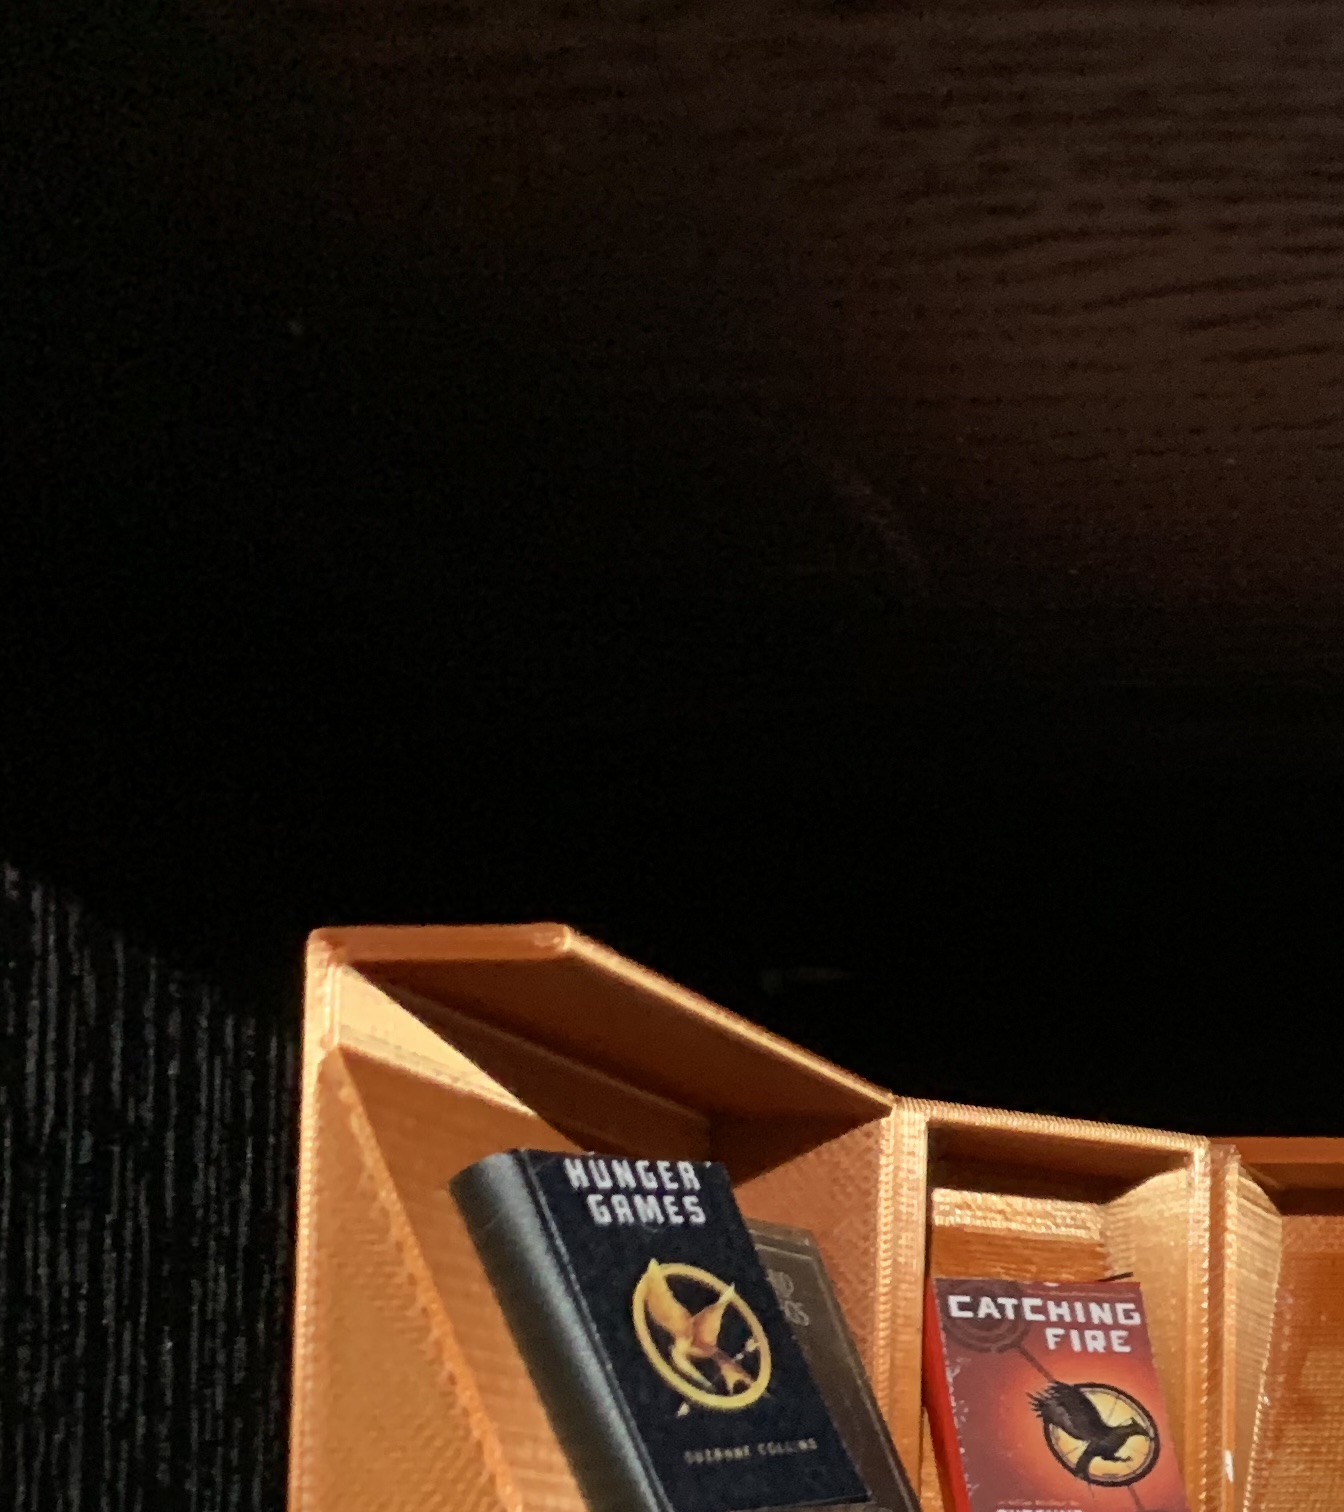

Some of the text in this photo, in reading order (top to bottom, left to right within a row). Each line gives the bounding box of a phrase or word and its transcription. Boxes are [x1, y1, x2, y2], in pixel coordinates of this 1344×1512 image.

[563, 1158, 701, 1191] HUNGER
[586, 1193, 706, 1226] GAMES
[948, 1295, 1141, 1325] CATCHING
[1045, 1328, 1132, 1353] FIRE
